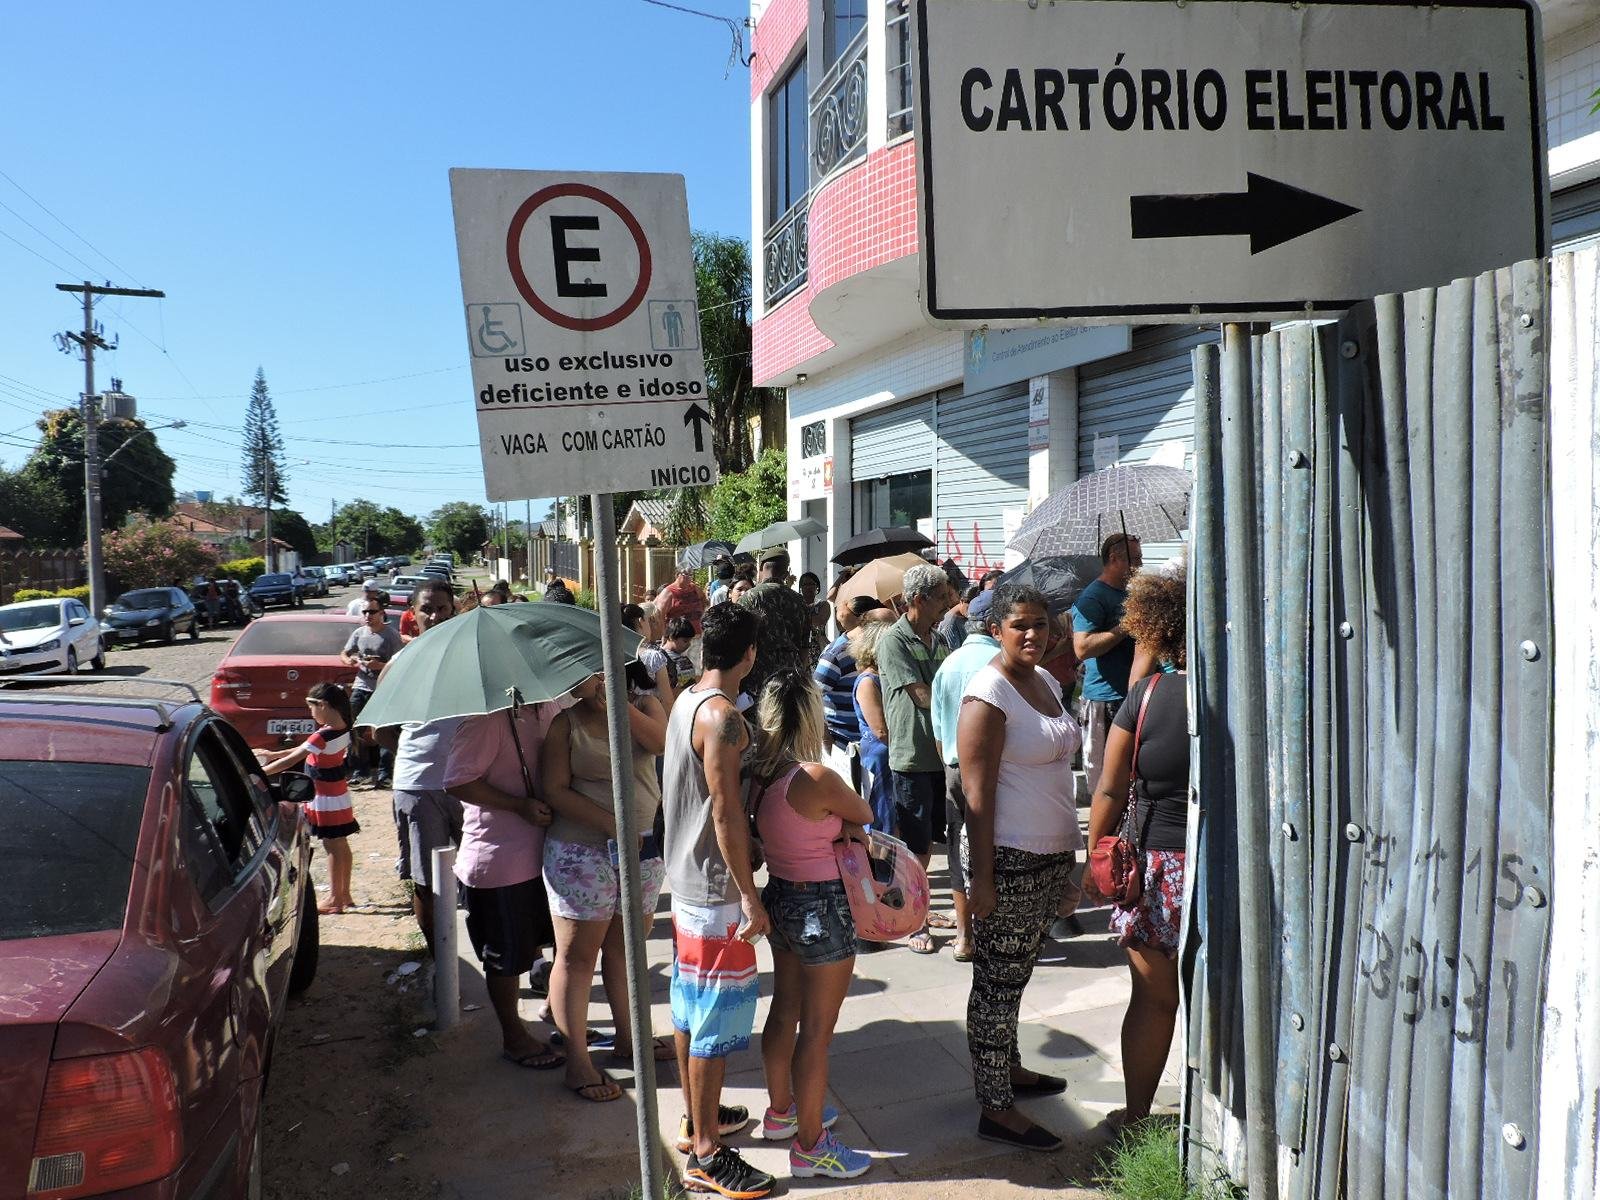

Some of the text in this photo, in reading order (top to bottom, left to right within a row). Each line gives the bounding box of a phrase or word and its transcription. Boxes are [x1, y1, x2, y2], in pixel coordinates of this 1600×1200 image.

[960, 53, 1505, 132] CARTÓRIO ELEITORAL
[550, 215, 607, 297] E
[505, 351, 673, 372] uso exclusivo
[480, 378, 702, 405] deficiente e idoso
[500, 424, 666, 455] VAGA COM CARTÃO
[651, 465, 711, 487] INÍCIO
